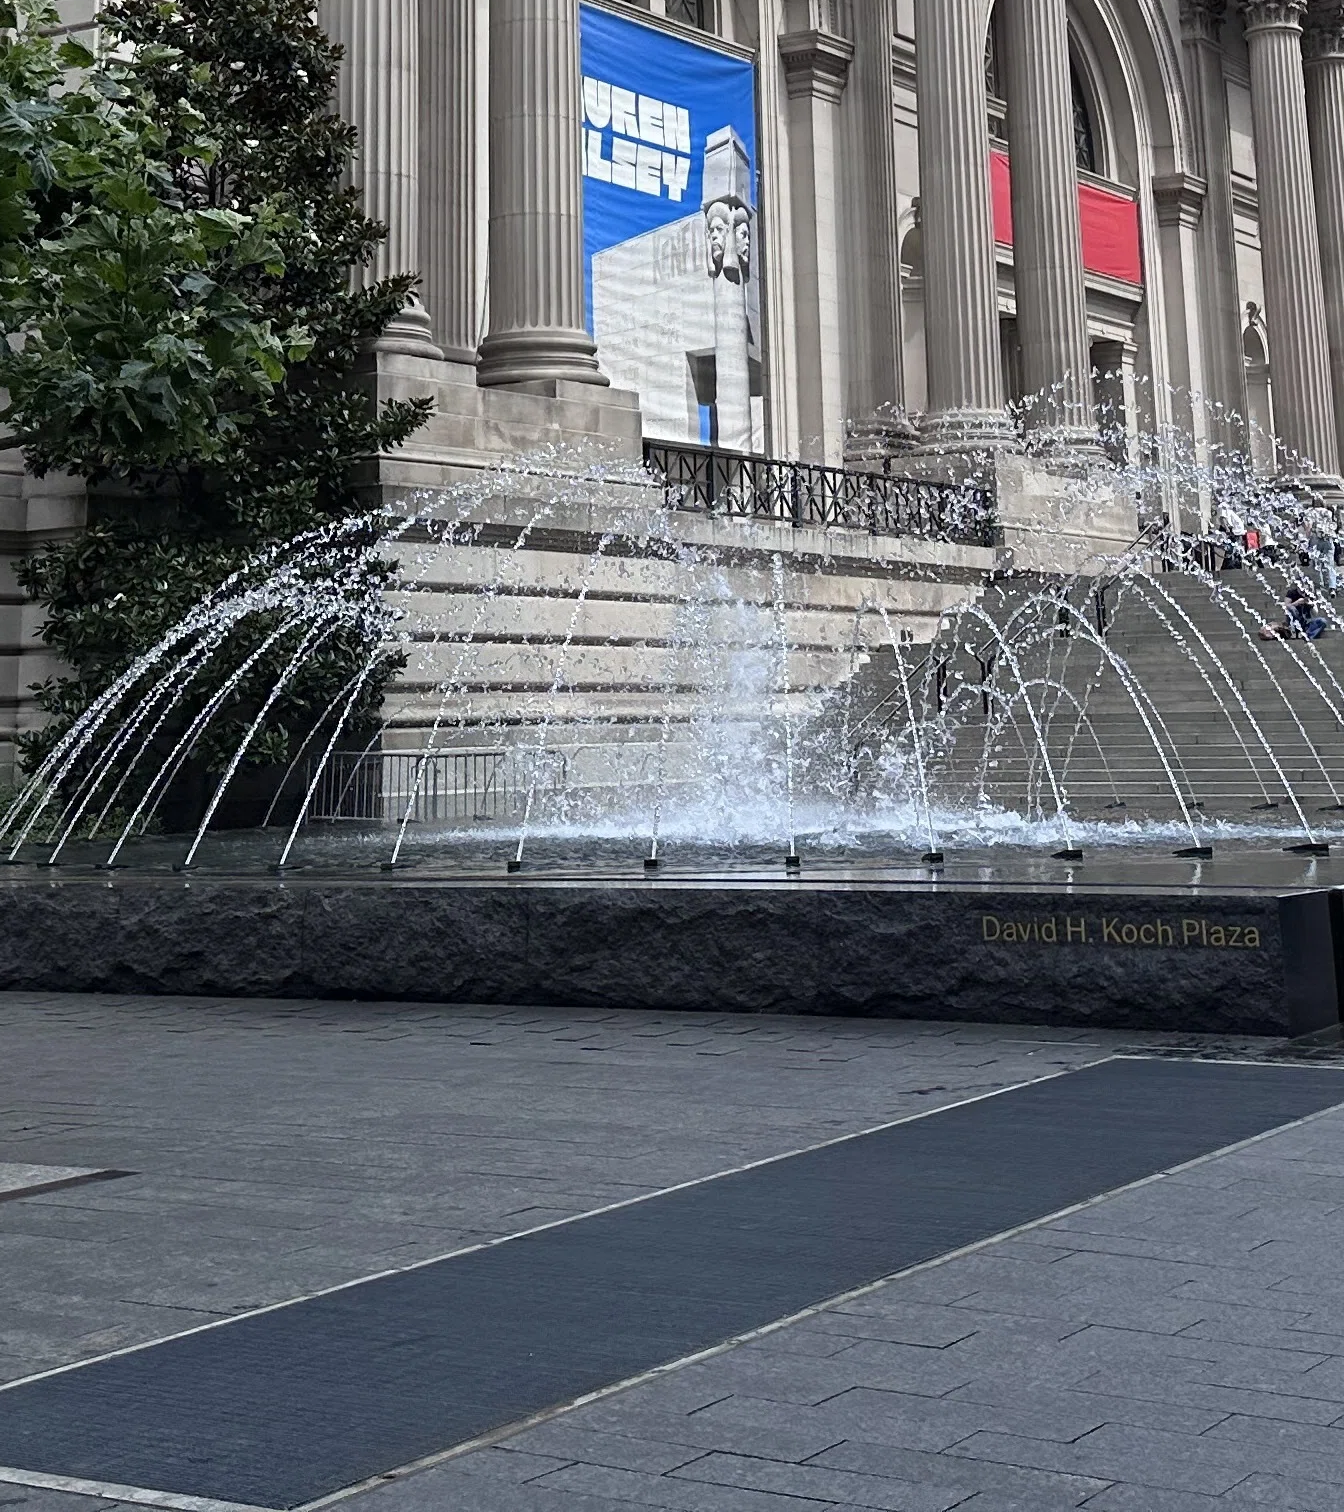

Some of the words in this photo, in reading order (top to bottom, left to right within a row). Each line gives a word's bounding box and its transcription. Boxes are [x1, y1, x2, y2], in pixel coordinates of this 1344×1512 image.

[581, 75, 691, 154] UREN
[581, 127, 691, 202] LSEY
[982, 916, 1056, 944] David
[1067, 918, 1094, 944] H.
[1102, 917, 1173, 945] Koch
[1183, 919, 1260, 947] Plaza
